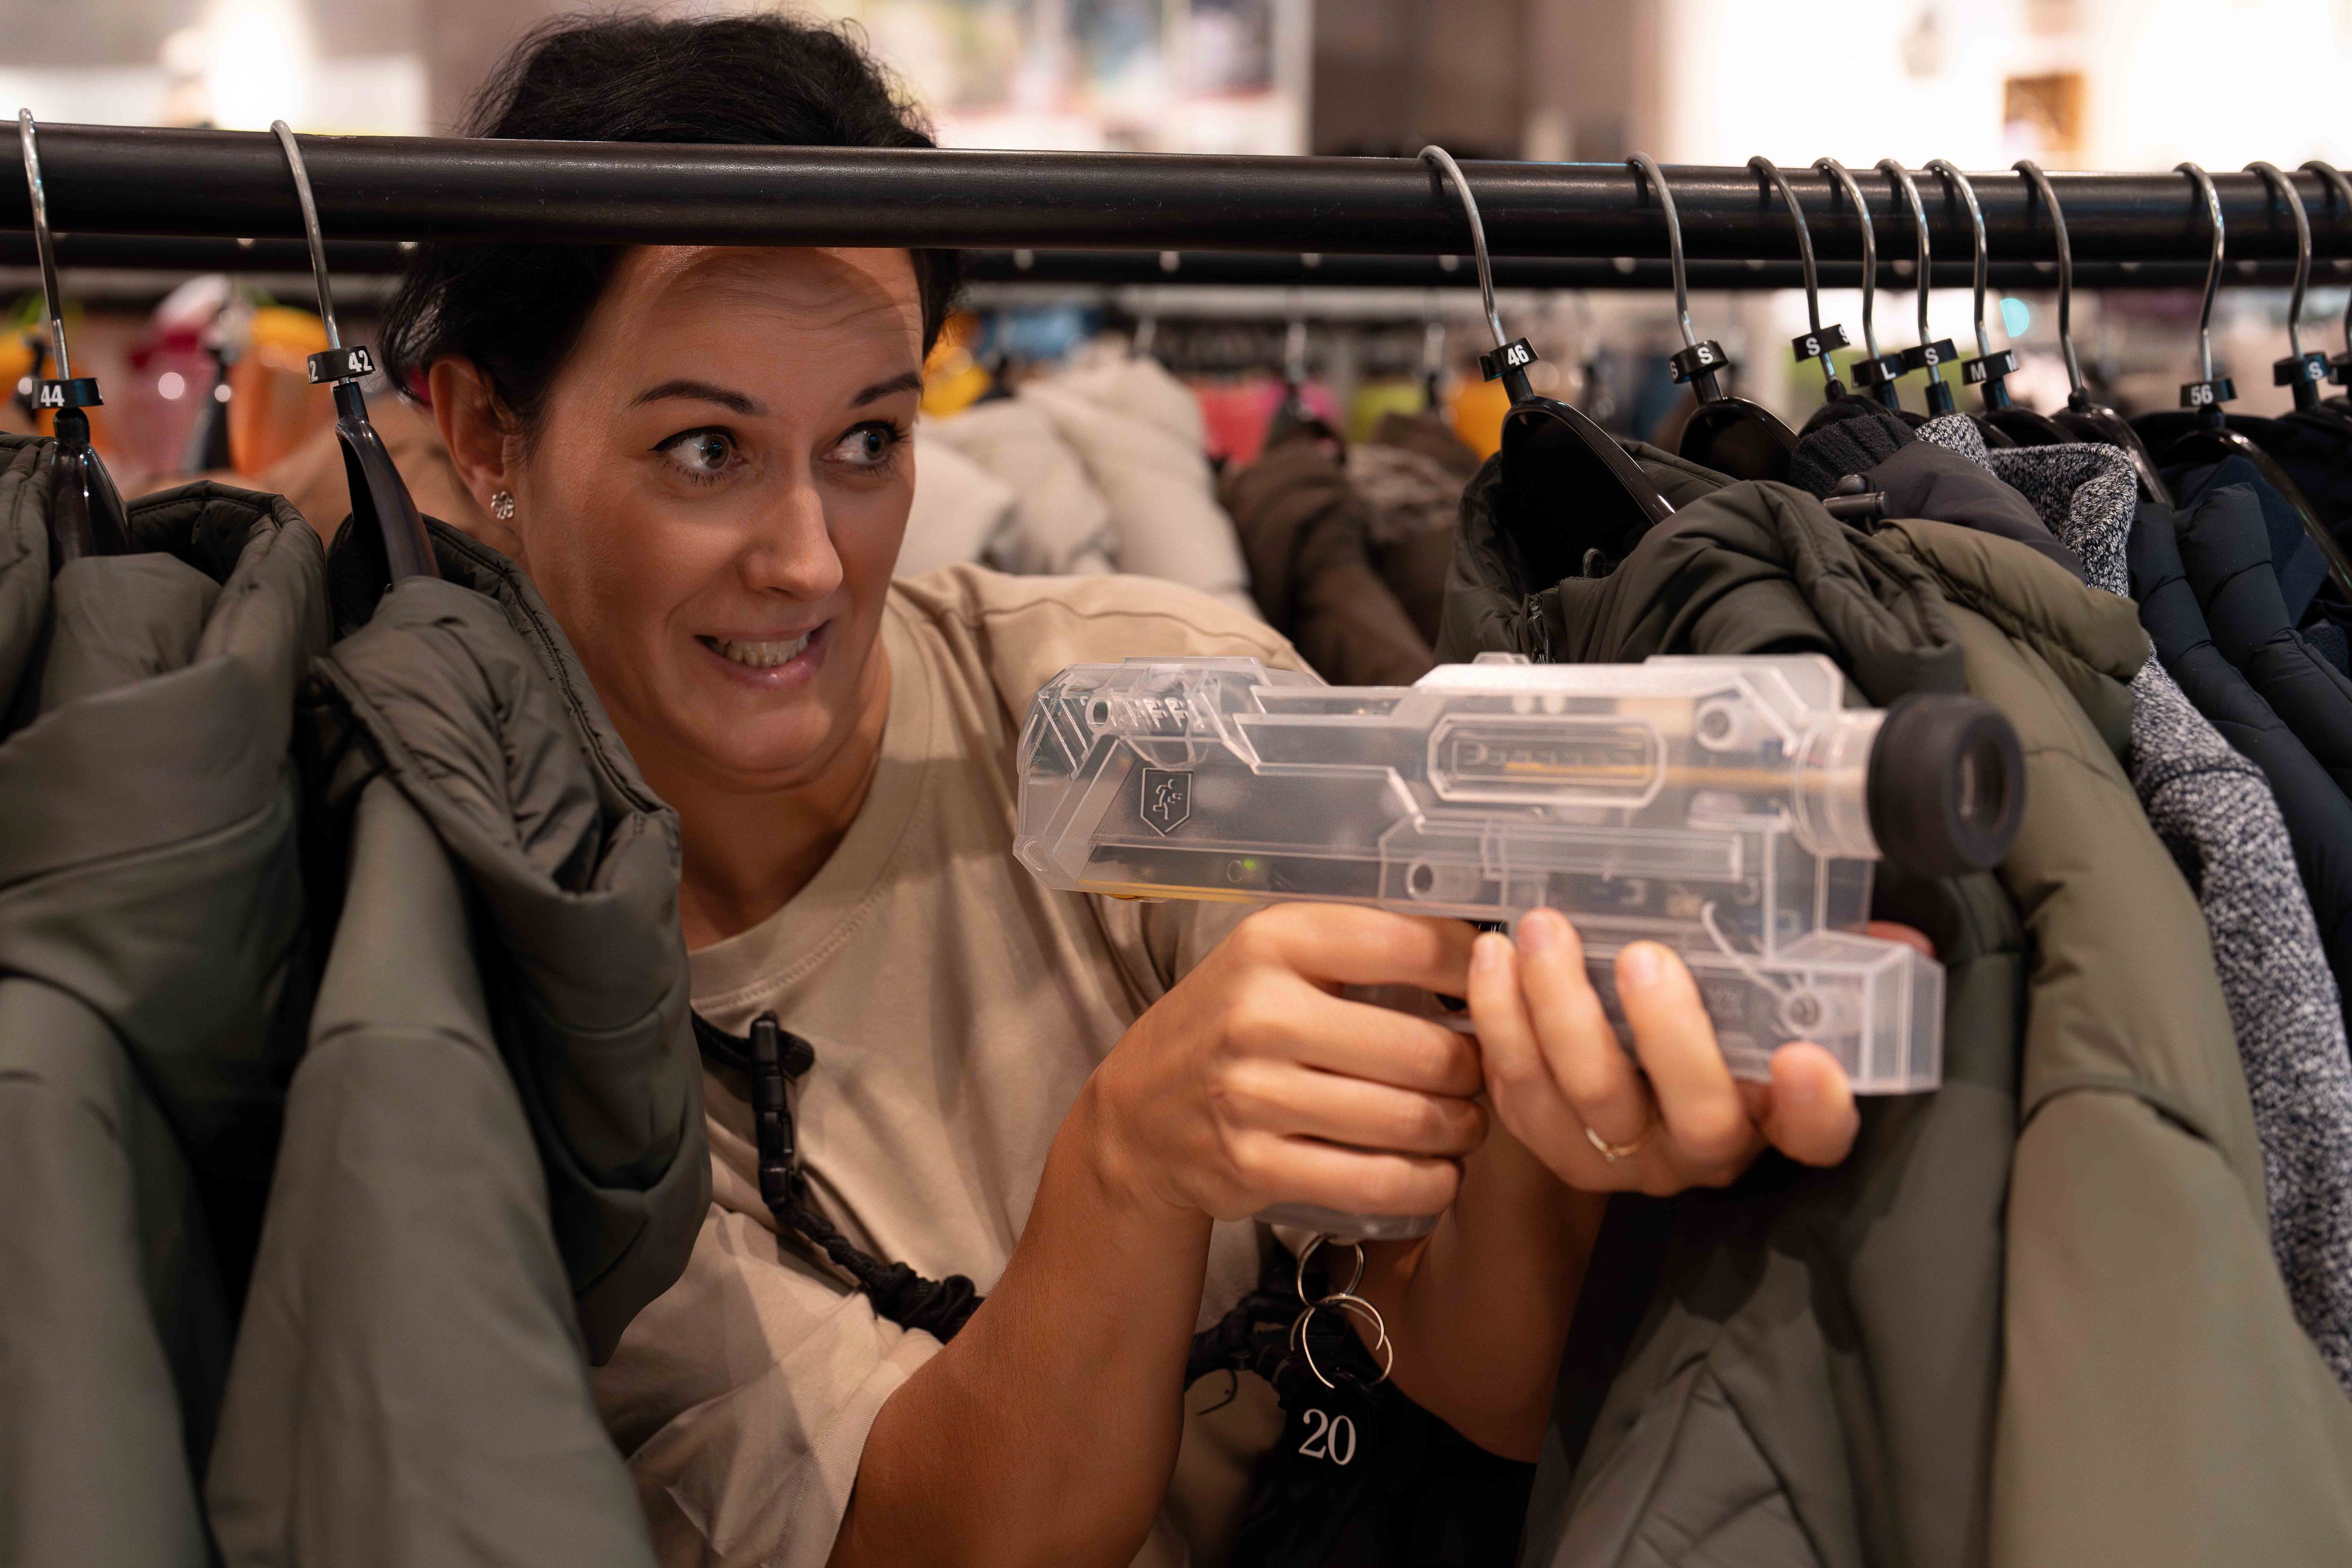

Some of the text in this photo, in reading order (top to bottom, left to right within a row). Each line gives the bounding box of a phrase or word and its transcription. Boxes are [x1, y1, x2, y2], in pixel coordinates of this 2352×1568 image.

[1508, 344, 1529, 366] 46
[1697, 346, 1714, 365] S
[1805, 337, 1821, 356] S
[1925, 347, 1939, 366] S
[348, 350, 372, 372] 42
[1880, 362, 1896, 380] L
[2308, 361, 2324, 380] S
[309, 360, 319, 383] 2
[1970, 362, 1987, 382] M
[41, 385, 65, 407] 44
[2190, 384, 2214, 405] 56
[1298, 1409, 1357, 1466] 20
